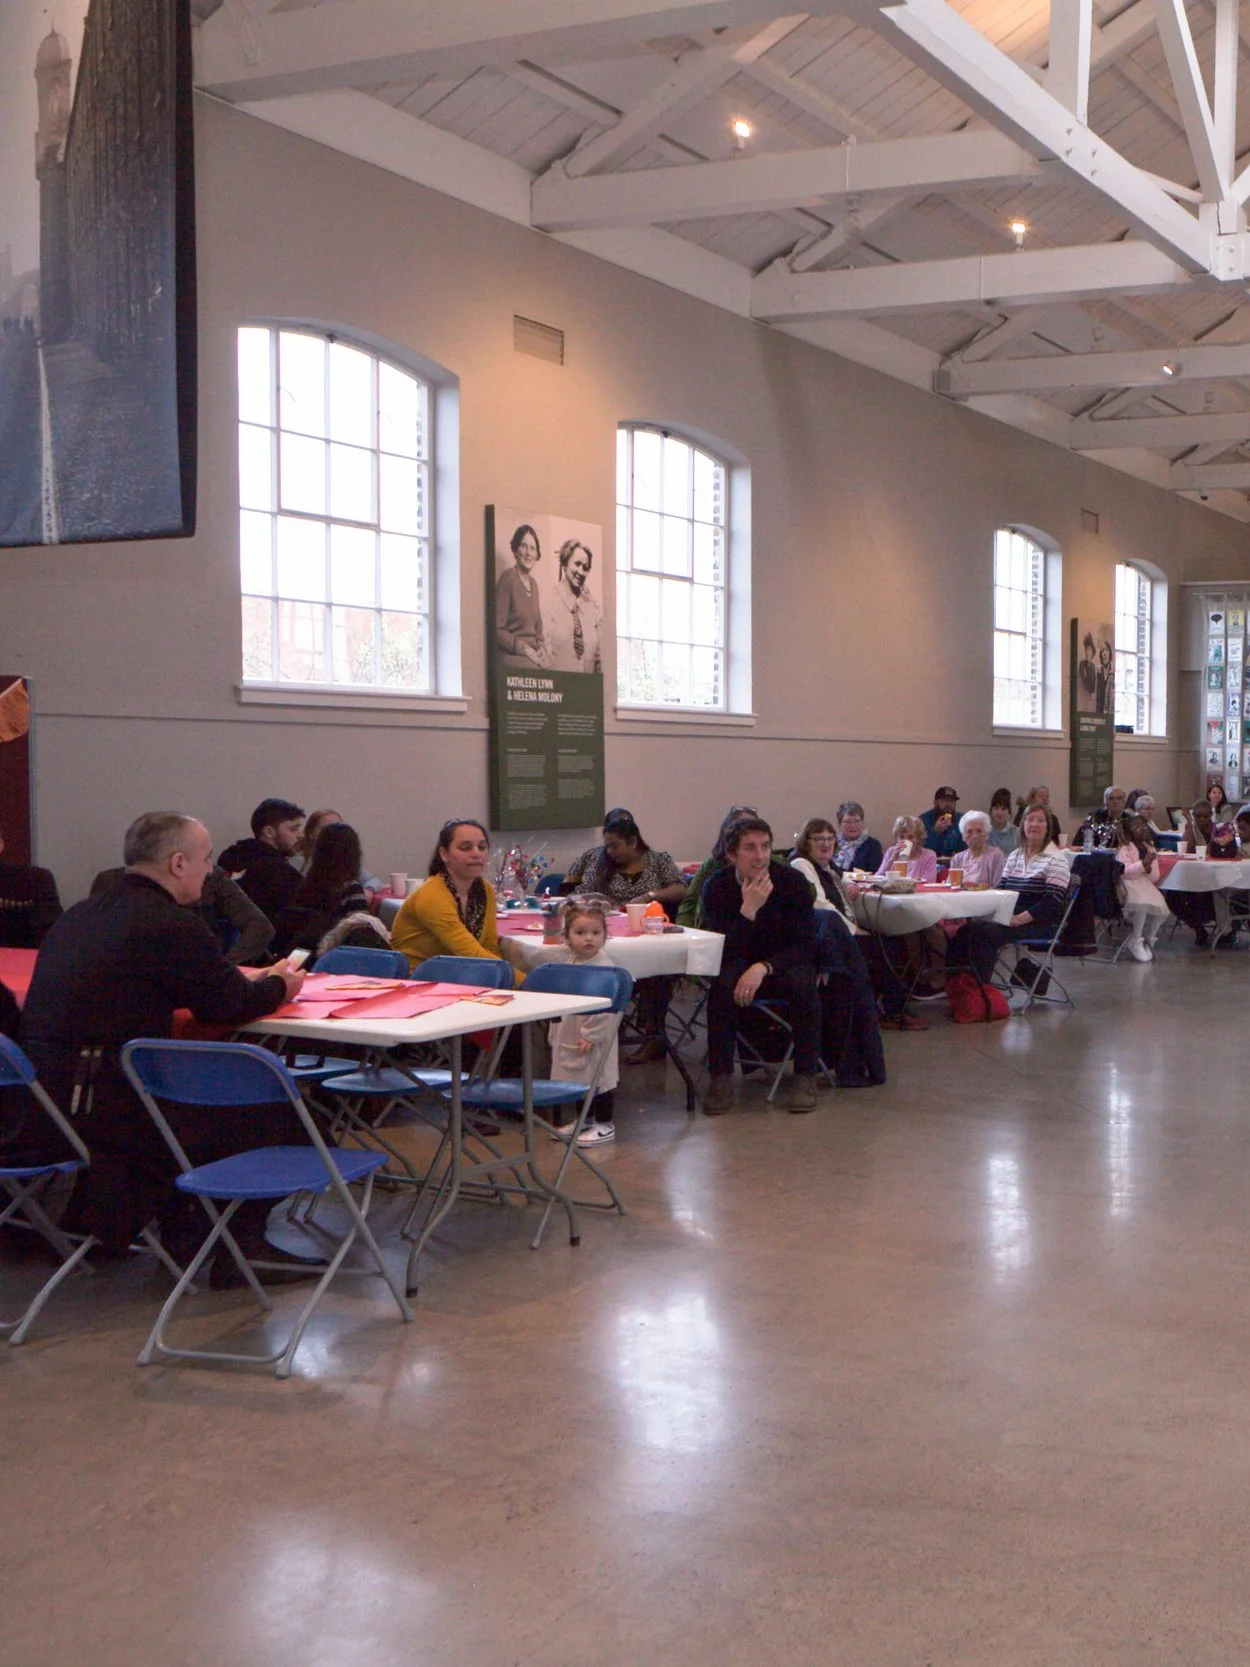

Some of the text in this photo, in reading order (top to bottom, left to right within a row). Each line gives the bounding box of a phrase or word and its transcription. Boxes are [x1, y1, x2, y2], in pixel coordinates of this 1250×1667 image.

[507, 676, 553, 689] KATHLEEN LYNN
[507, 690, 512, 701] &
[513, 690, 537, 702] HELENA
